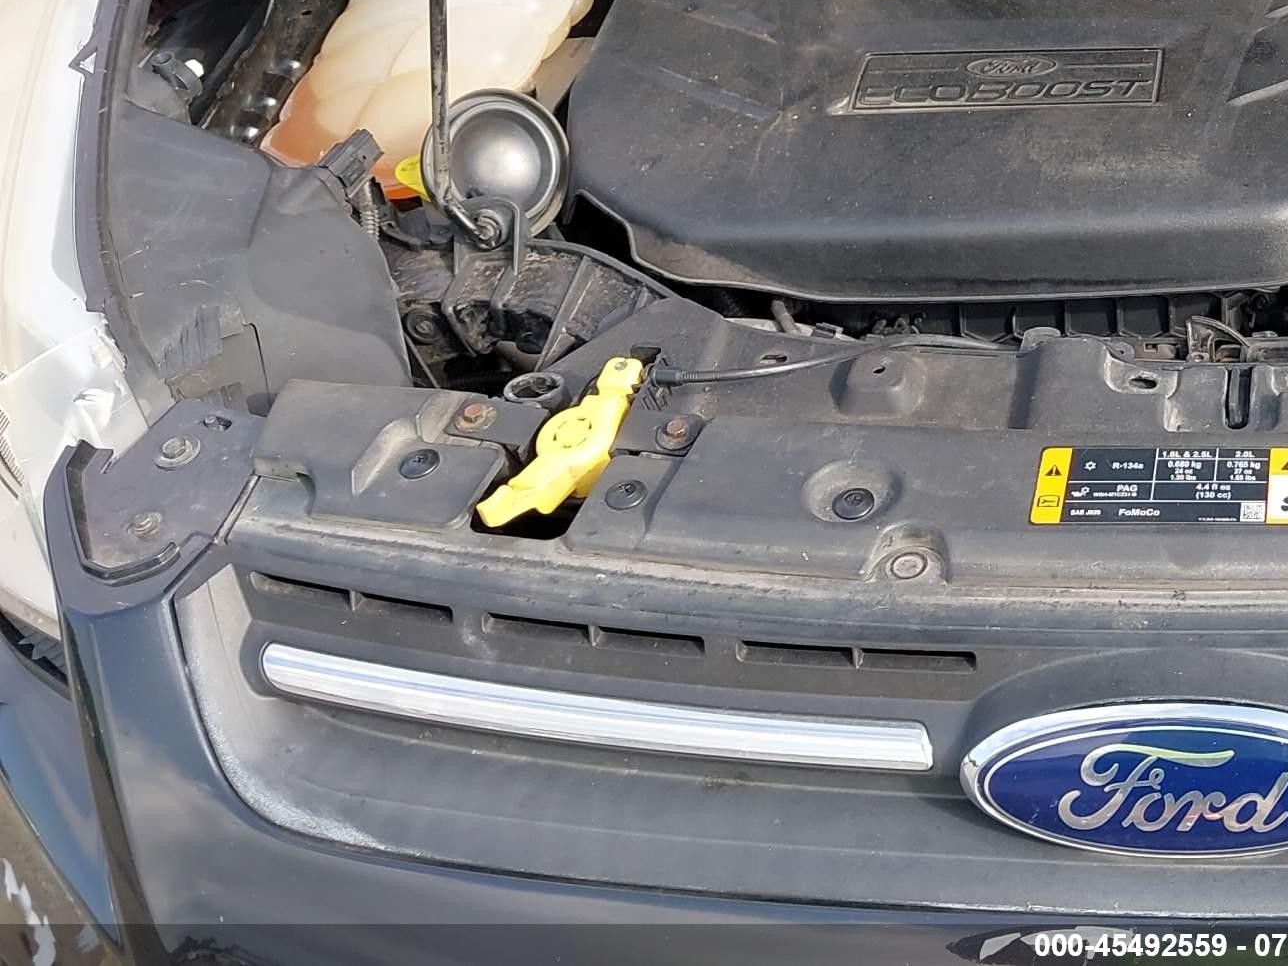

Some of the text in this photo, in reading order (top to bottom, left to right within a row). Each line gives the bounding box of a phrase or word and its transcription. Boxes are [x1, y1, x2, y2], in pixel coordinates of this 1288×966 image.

[980, 57, 1040, 75] Ford
[860, 79, 1153, 106] ECOBOOST
[1183, 450, 1191, 458] &
[1234, 450, 1255, 458] 2.0L
[1111, 461, 1144, 470] R-134a
[1191, 460, 1202, 470] kg
[1249, 460, 1261, 470] kg
[1116, 484, 1138, 492] PAG
[1195, 483, 1210, 491] 4.4
[1195, 492, 1231, 500] (130 cc)
[1118, 508, 1161, 516] FoMoCo
